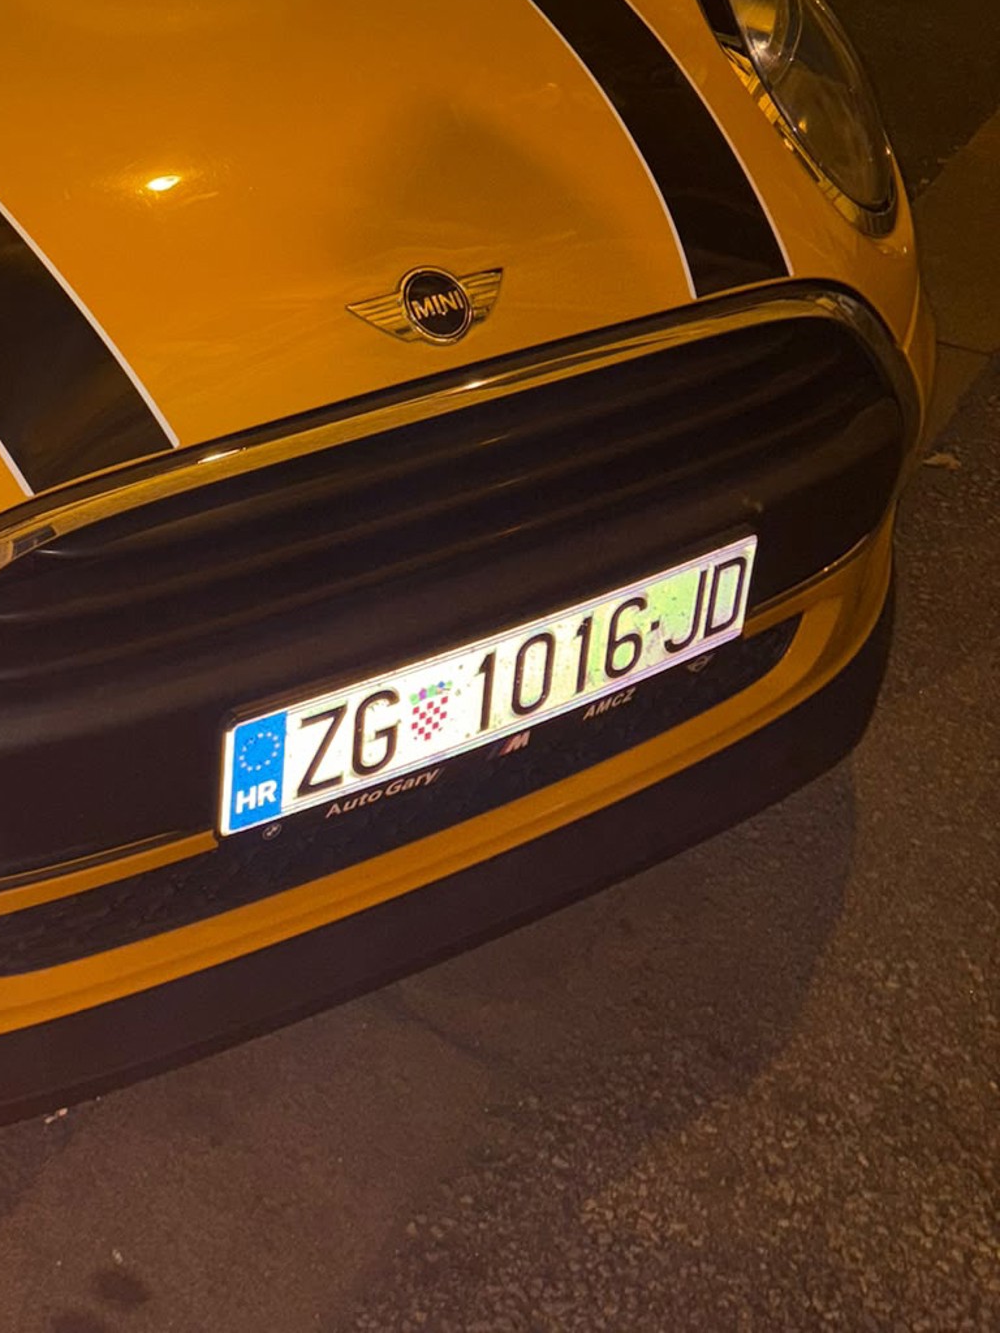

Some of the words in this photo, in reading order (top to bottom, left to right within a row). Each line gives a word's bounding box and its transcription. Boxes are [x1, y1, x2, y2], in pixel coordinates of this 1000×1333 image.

[411, 290, 463, 320] MINI
[296, 690, 399, 798] ZG
[236, 780, 277, 814] HR
[325, 789, 382, 818] Auto
[385, 768, 439, 797] Gary
